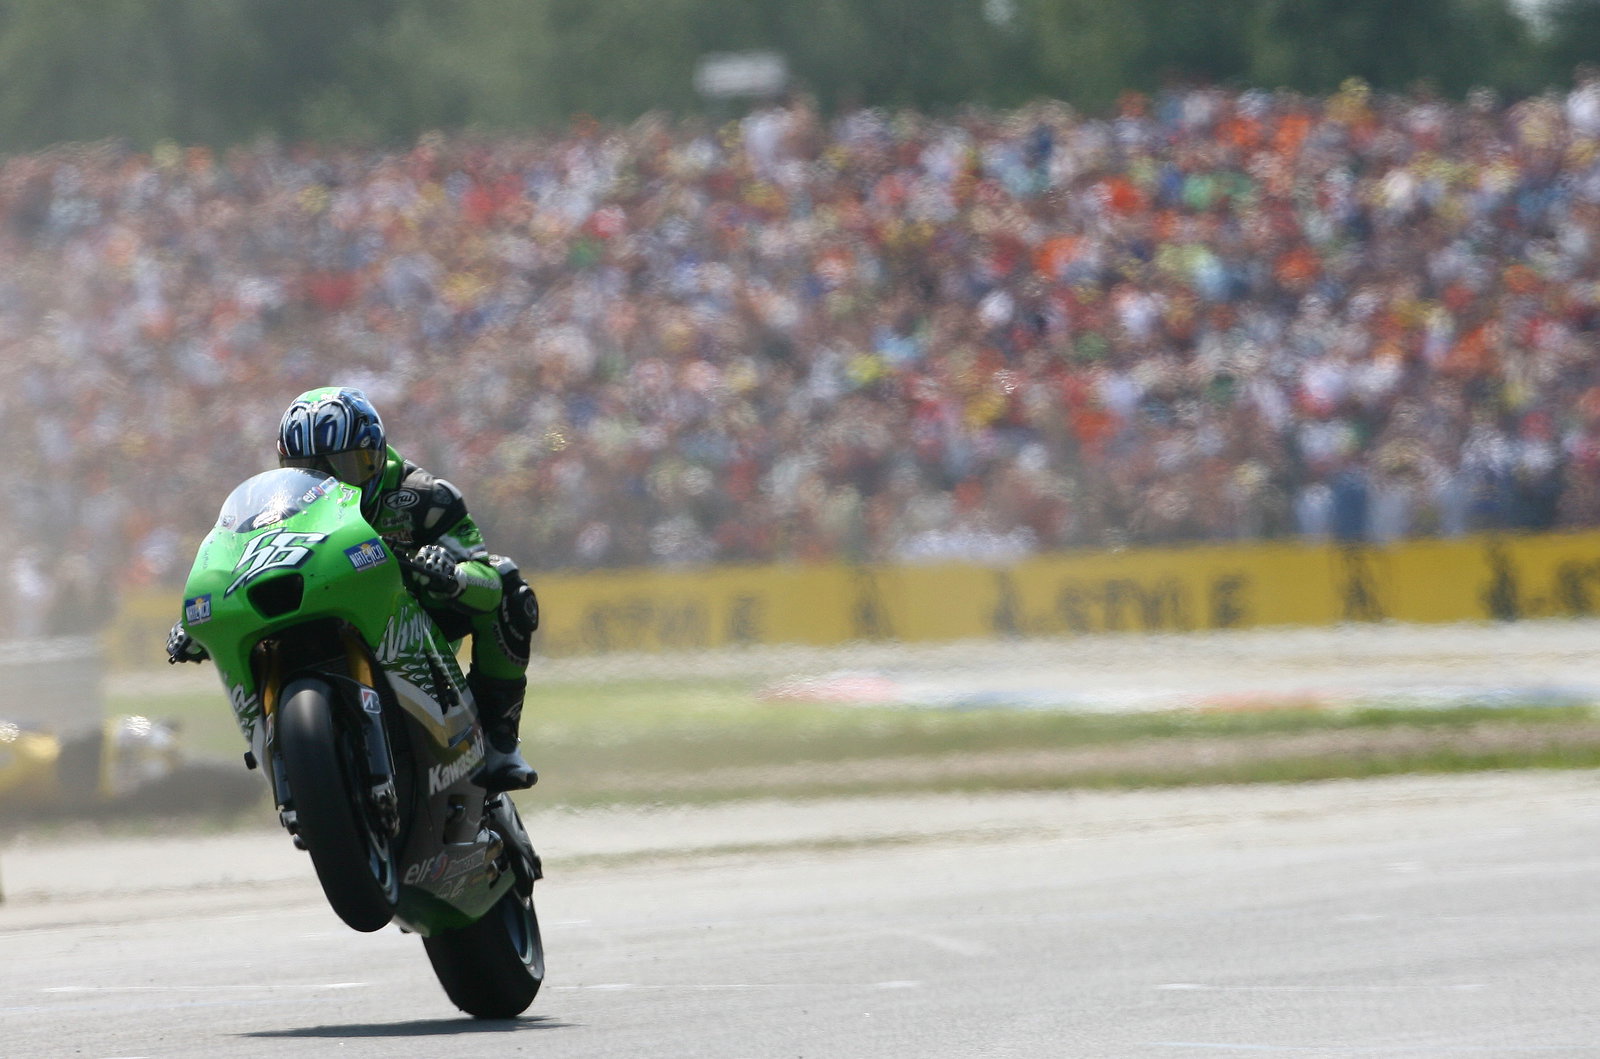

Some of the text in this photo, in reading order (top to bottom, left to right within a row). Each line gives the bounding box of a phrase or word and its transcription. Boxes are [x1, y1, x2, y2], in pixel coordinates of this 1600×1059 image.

[302, 489, 318, 504] elf
[428, 728, 485, 796] Kawasaki
[403, 856, 435, 885] elf
